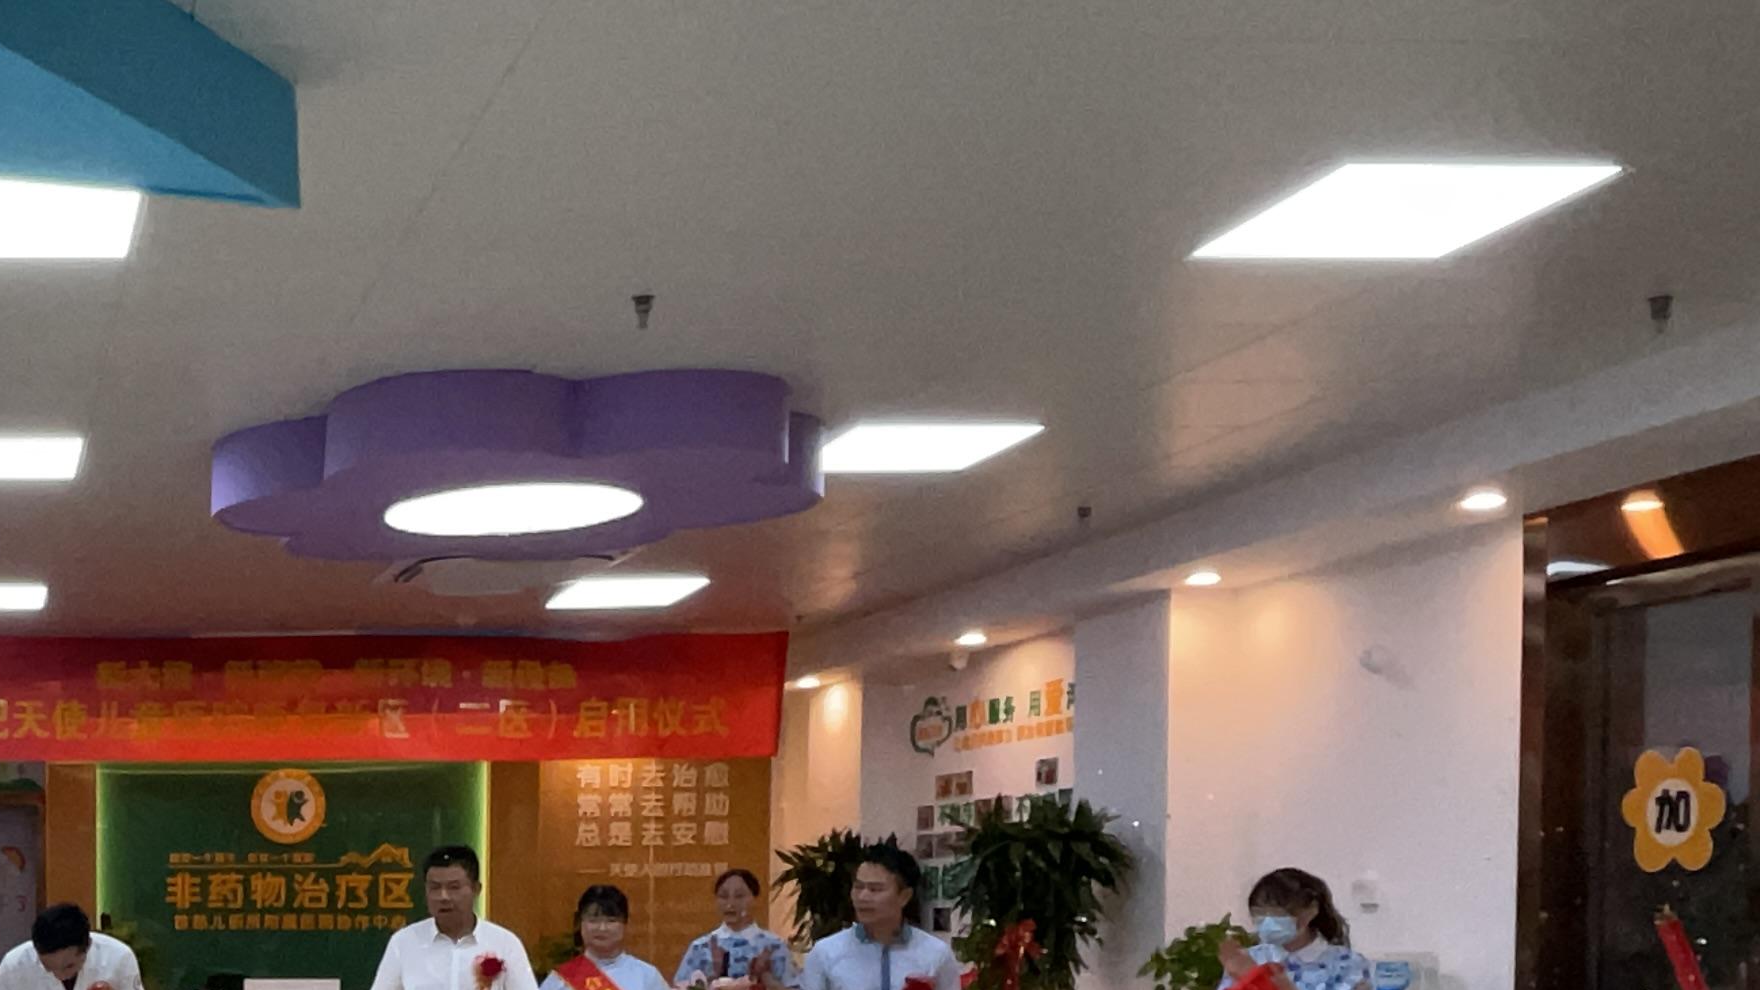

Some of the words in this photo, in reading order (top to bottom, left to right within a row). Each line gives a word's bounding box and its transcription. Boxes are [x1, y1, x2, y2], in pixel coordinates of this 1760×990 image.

[576, 792, 730, 817] 常常去帮助
[165, 872, 414, 909] 非药物治疗区
